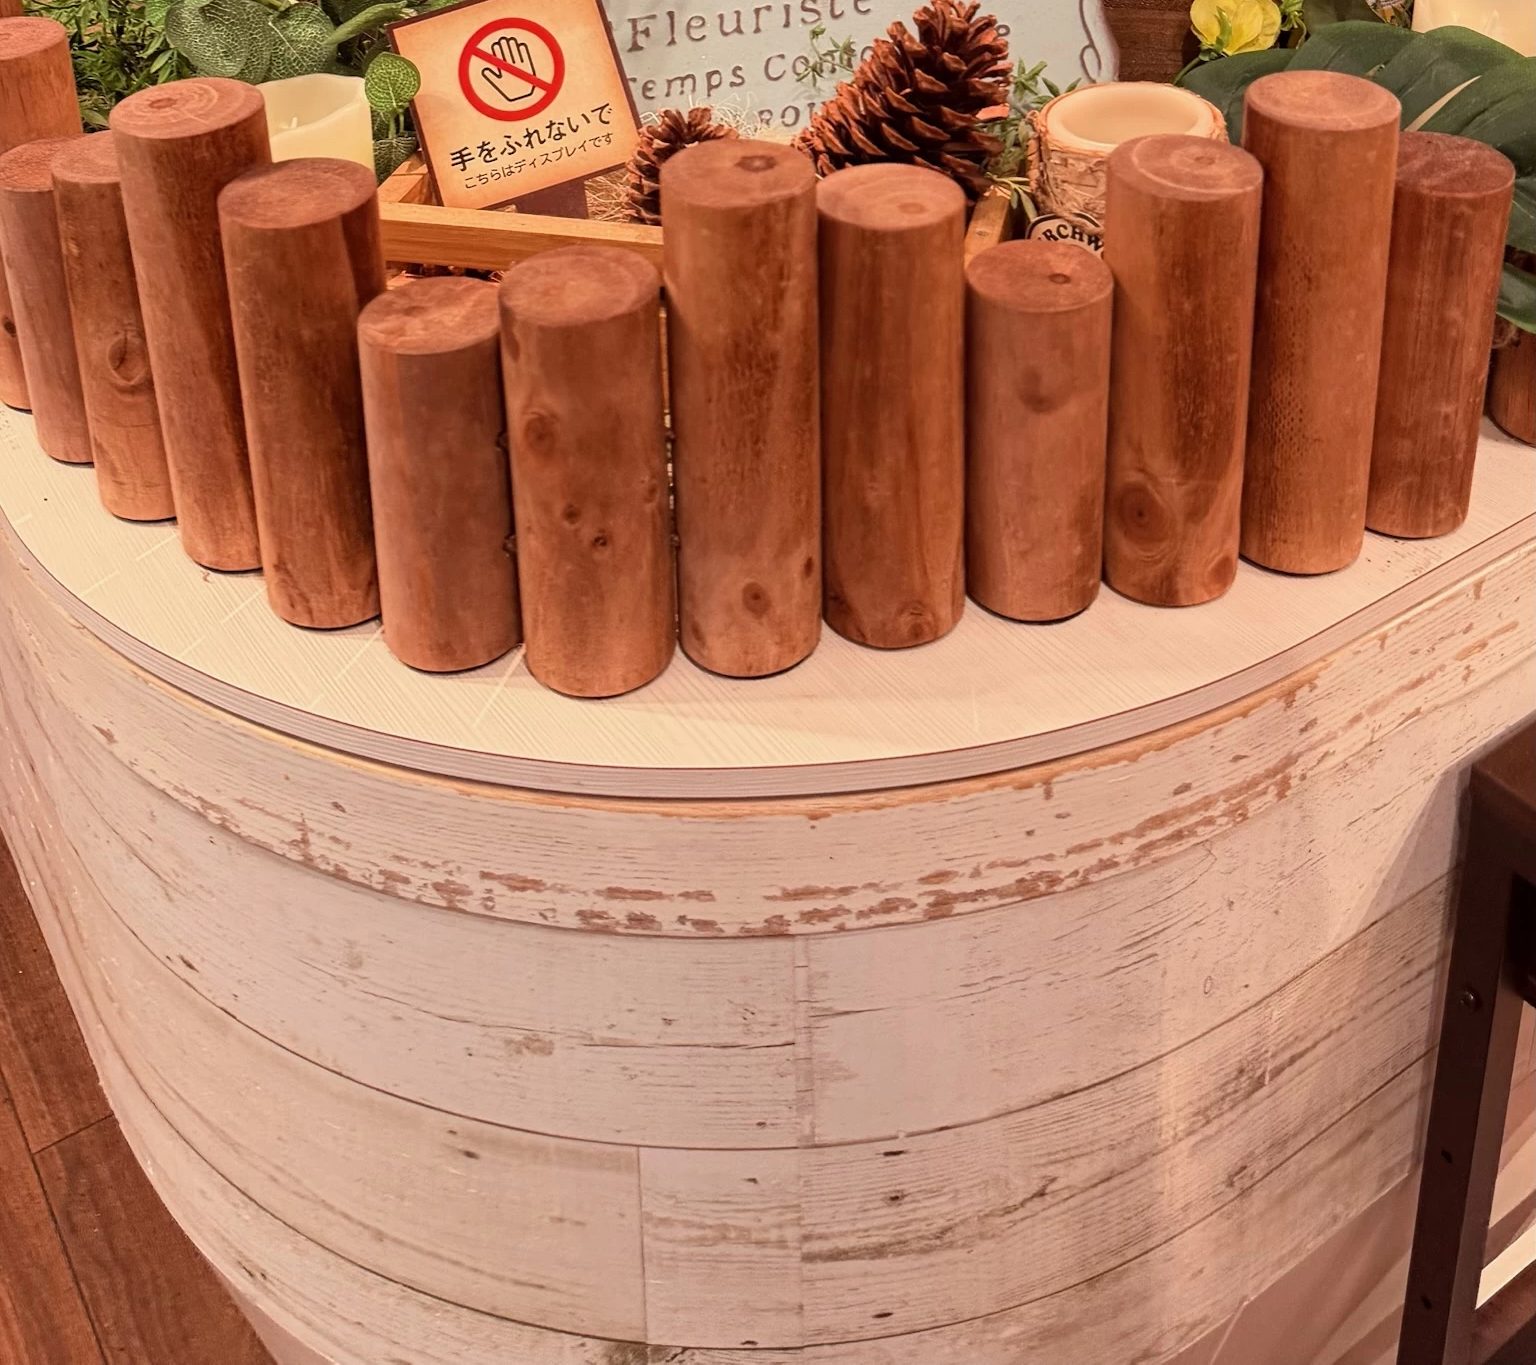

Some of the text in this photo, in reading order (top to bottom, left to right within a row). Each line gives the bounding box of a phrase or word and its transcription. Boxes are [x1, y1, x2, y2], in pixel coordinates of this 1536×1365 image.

[627, 65, 746, 101] emps
[449, 102, 613, 172] 手をふれないで
[464, 131, 615, 190] こちらはディスプレイです
